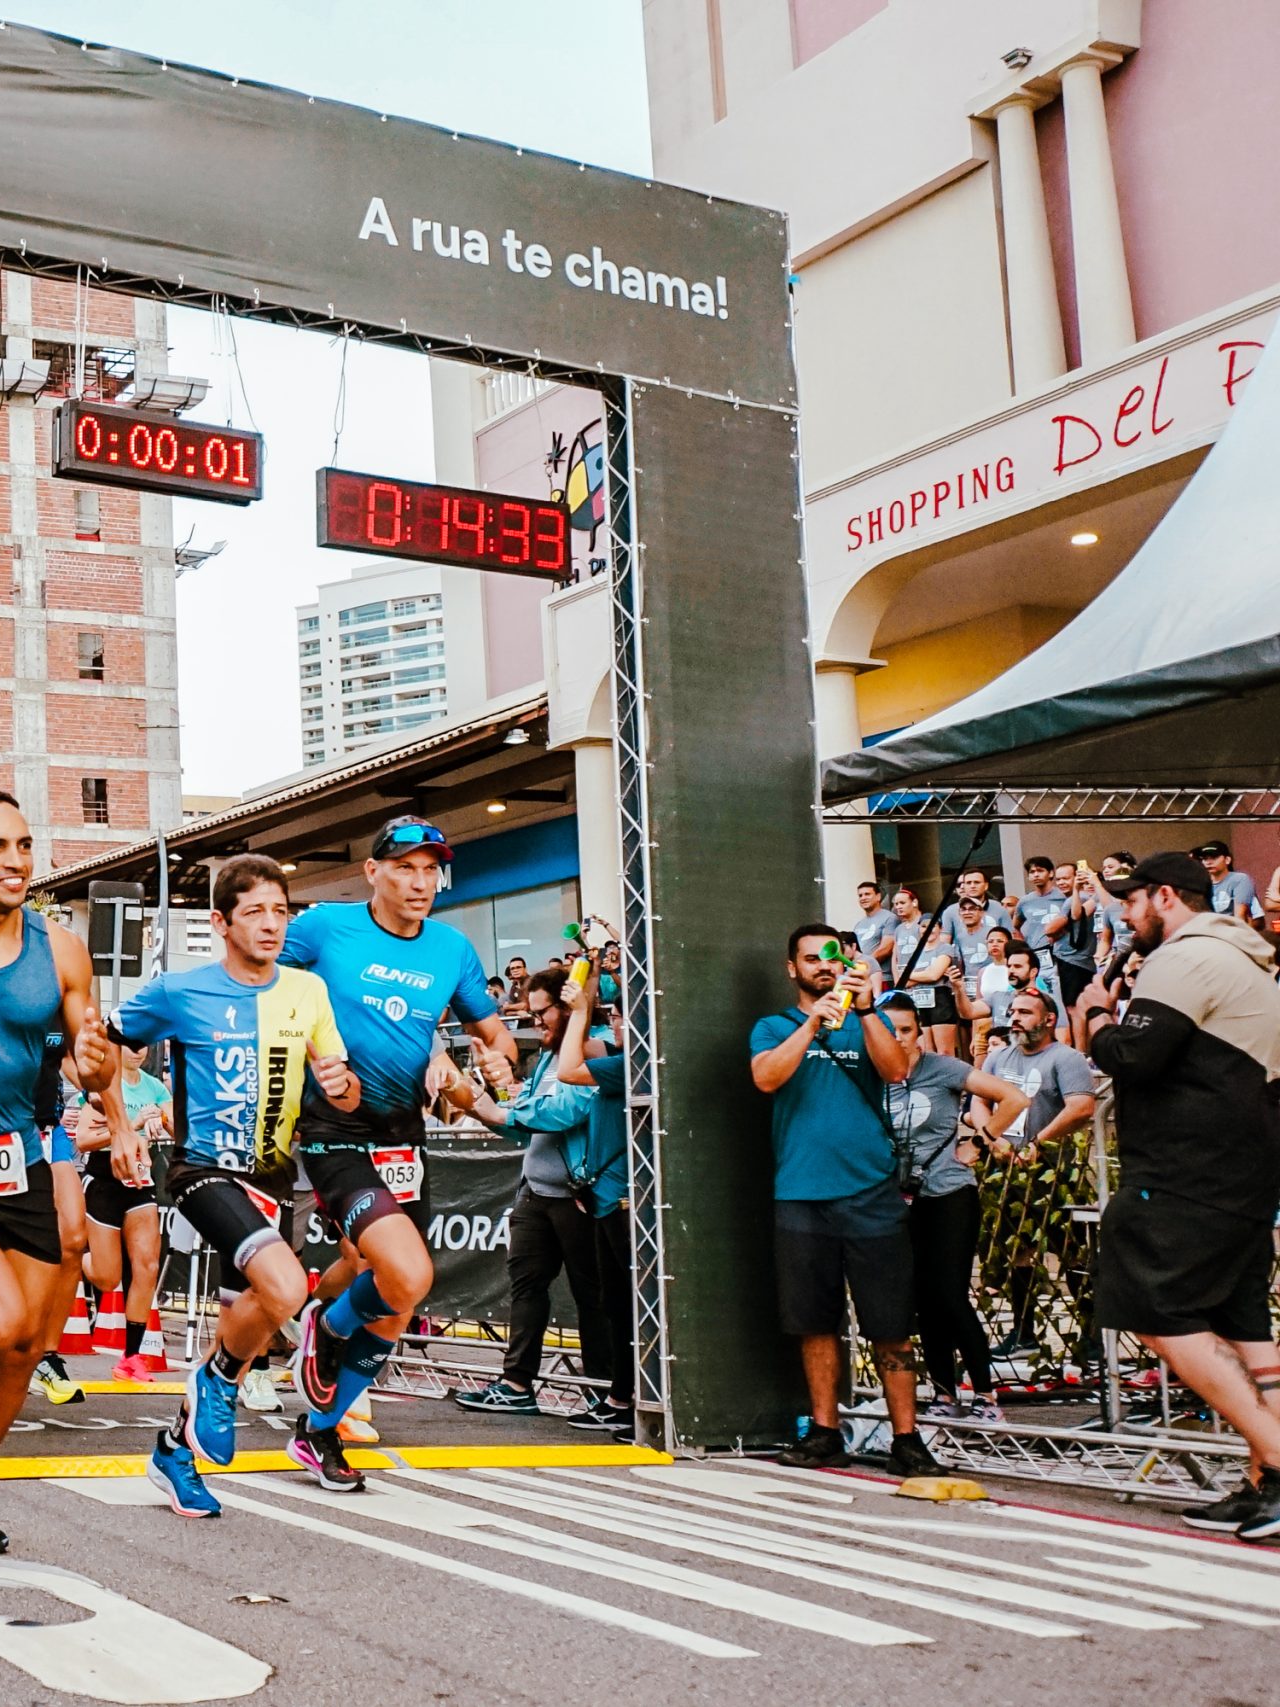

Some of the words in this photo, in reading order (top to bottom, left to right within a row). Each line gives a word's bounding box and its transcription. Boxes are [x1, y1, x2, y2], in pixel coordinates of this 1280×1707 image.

[359, 197, 399, 246] A
[412, 217, 490, 265] rua
[502, 229, 553, 278] te
[565, 246, 729, 320] chama!
[76, 415, 251, 486] 0:00:01
[847, 456, 1015, 553] SHOPPING
[1051, 358, 1176, 477] Del
[367, 482, 566, 570] 0:14:33
[214, 1045, 247, 1173] PEAKS
[245, 1046, 258, 1104] GROUP
[244, 1105, 257, 1175] COACHING
[378, 1165, 416, 1185] 053
[427, 1207, 513, 1251] MORÁ
